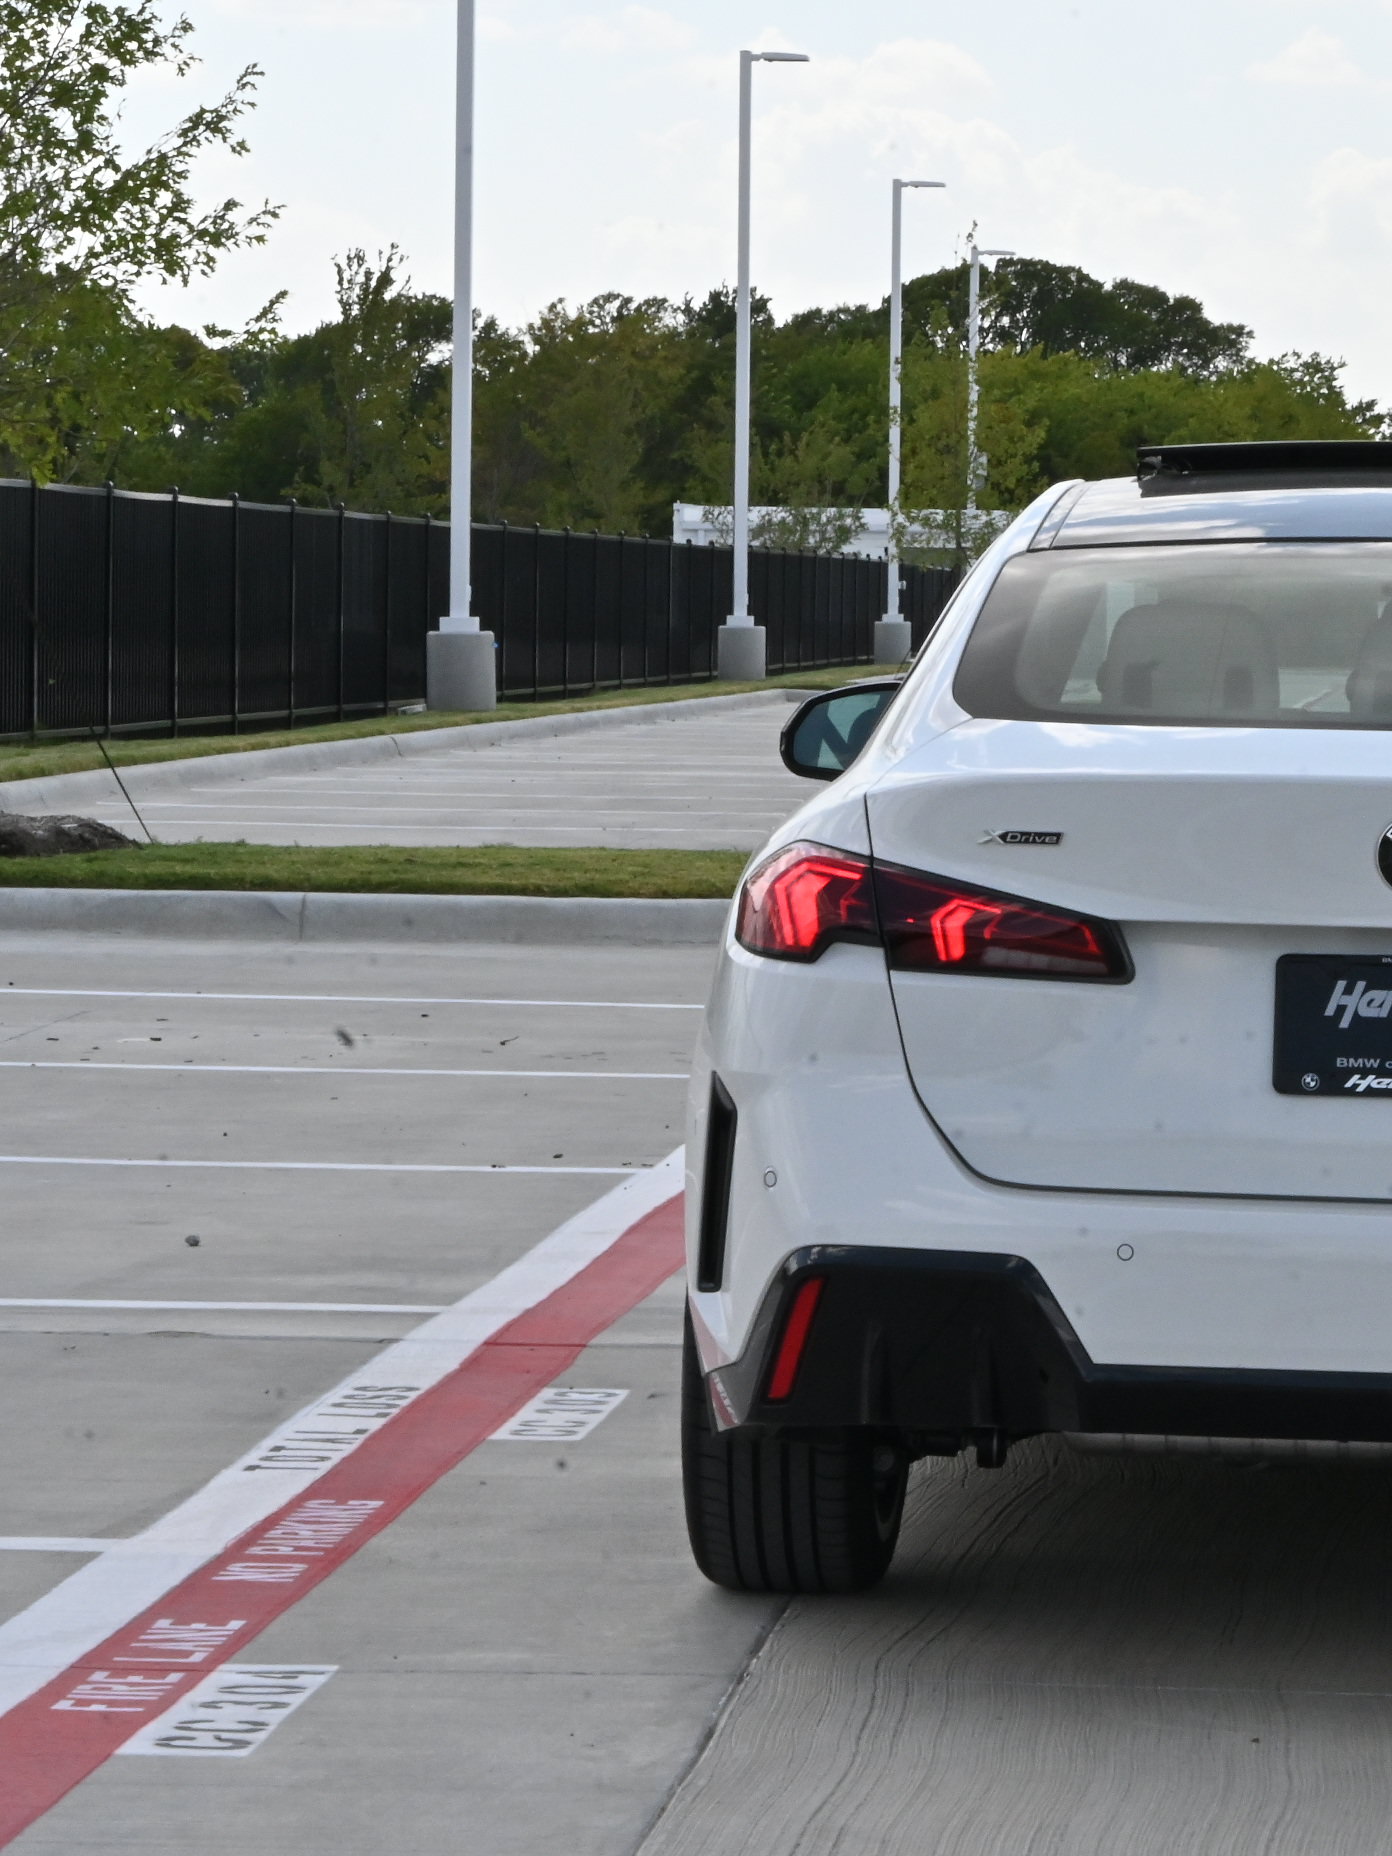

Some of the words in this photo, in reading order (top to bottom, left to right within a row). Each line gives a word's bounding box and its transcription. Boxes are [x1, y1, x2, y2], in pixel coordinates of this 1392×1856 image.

[1336, 1057, 1380, 1069] BMW
[243, 1427, 371, 1472] TOTAL
[316, 1385, 421, 1418] LOSS
[244, 1499, 385, 1554] PARKING
[211, 1562, 309, 1582] NO
[112, 1618, 248, 1663] LANE
[50, 1670, 187, 1713] FIRE
